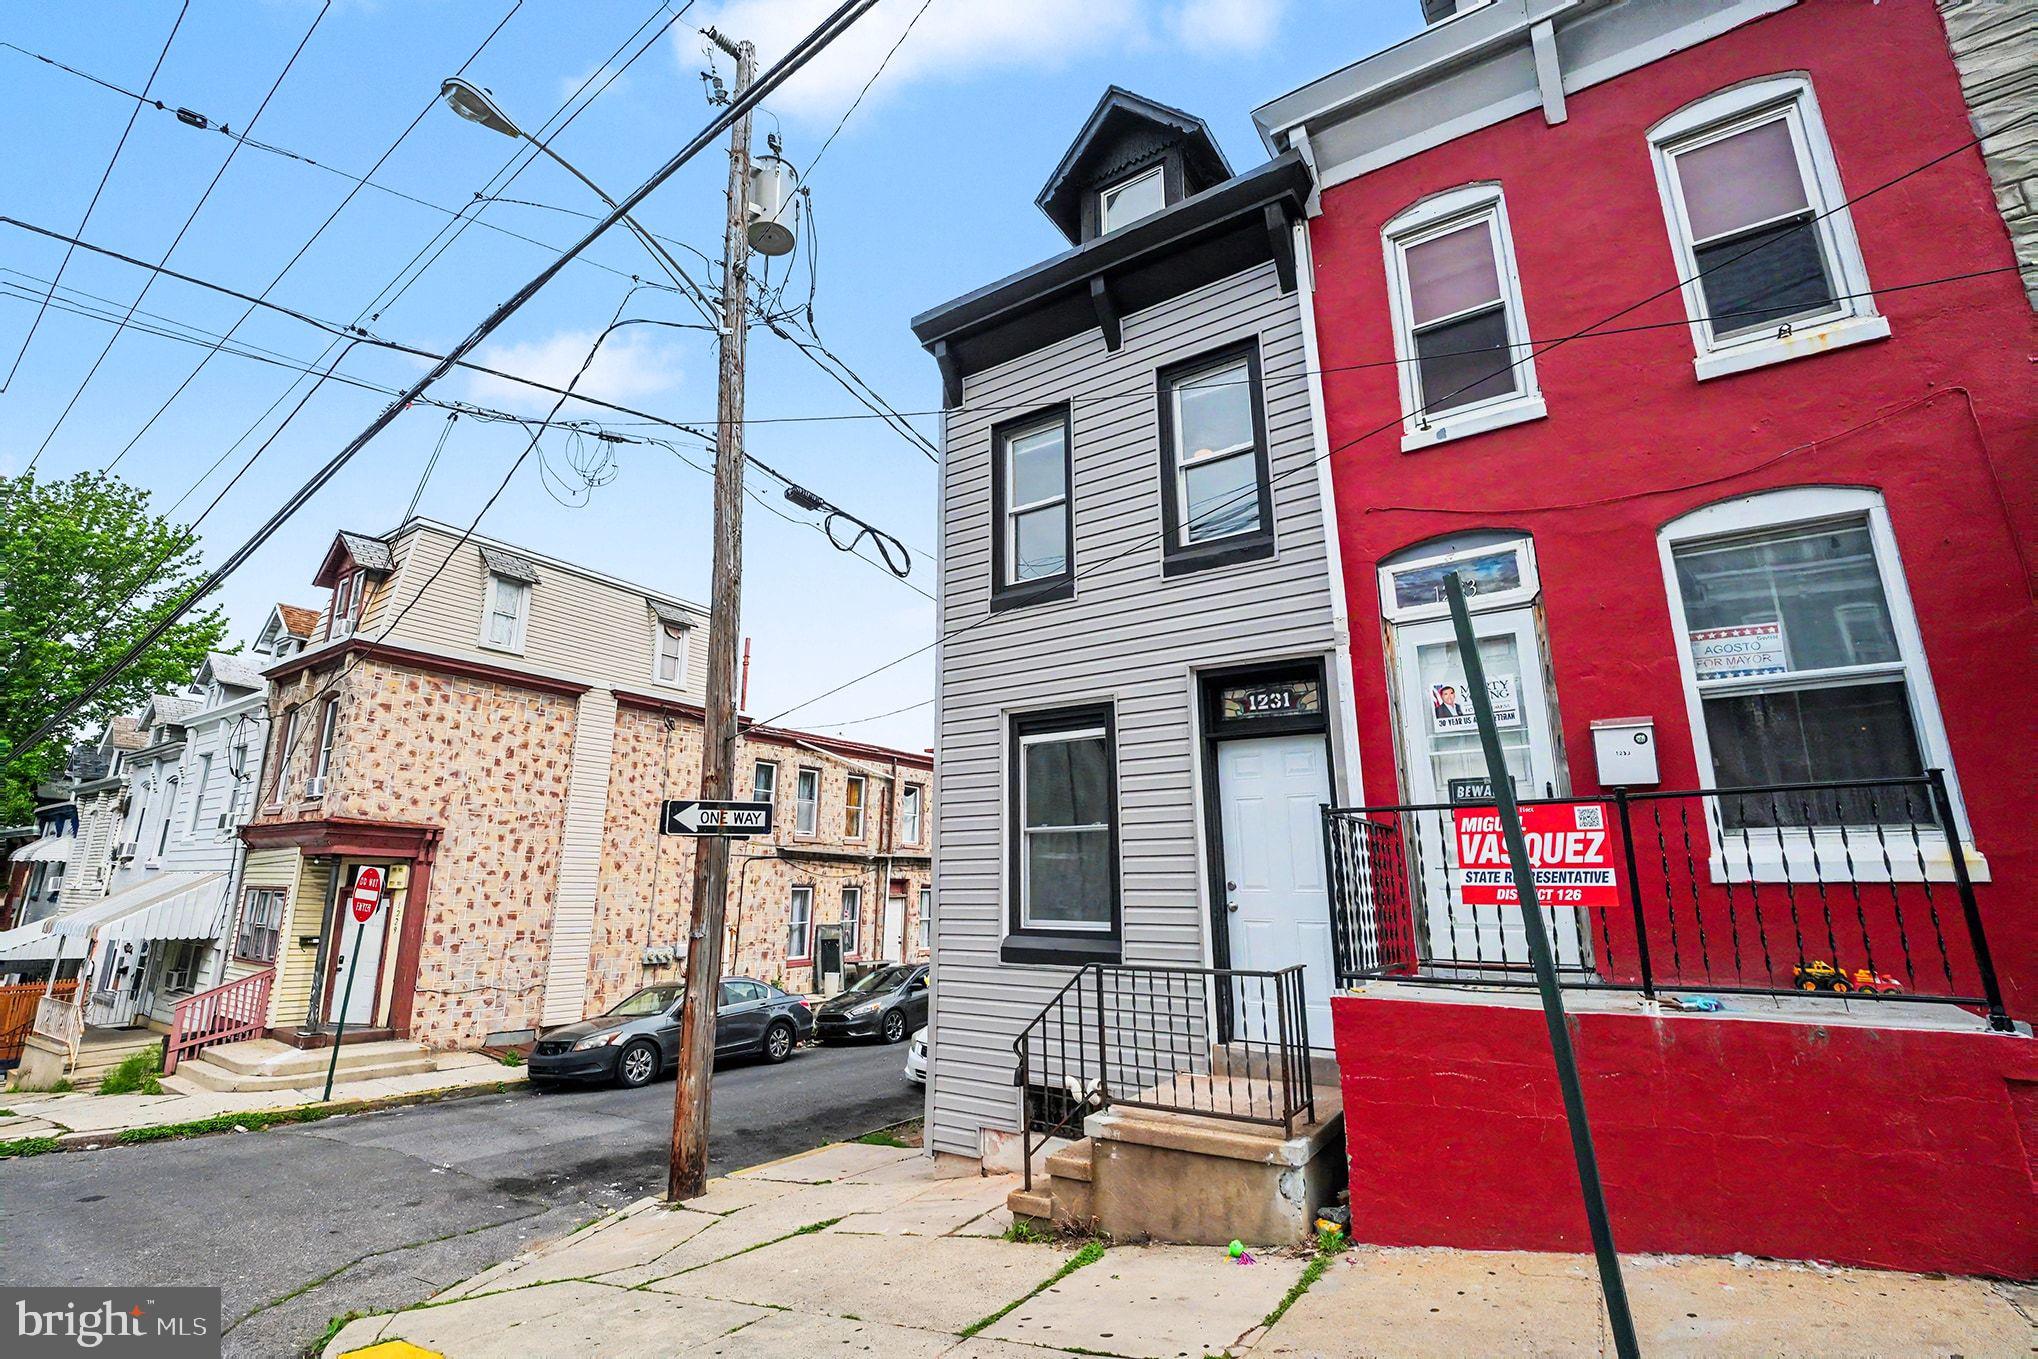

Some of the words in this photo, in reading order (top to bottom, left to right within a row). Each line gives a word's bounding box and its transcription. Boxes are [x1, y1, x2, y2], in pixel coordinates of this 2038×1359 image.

[1704, 641, 1761, 655] AGOSTO
[1696, 658, 1722, 668] FOR
[1726, 653, 1772, 666] MAYOR
[1460, 679, 1508, 694] MTY
[1249, 692, 1290, 711] 1231
[1461, 689, 1510, 702] YNG
[1463, 716, 1472, 725] US
[1457, 784, 1496, 798] BEWA
[700, 811, 728, 825] ONE
[733, 811, 762, 825] WAY
[1461, 816, 1526, 832] MIGUL
[360, 877, 367, 886] DO
[369, 879, 379, 888] NOT
[1465, 870, 1501, 884] STATE
[1504, 870, 1610, 884] RESENTATIVE
[1496, 888, 1553, 901] DISCT
[1557, 888, 1582, 901] 126
[356, 902, 371, 912] ENTER
